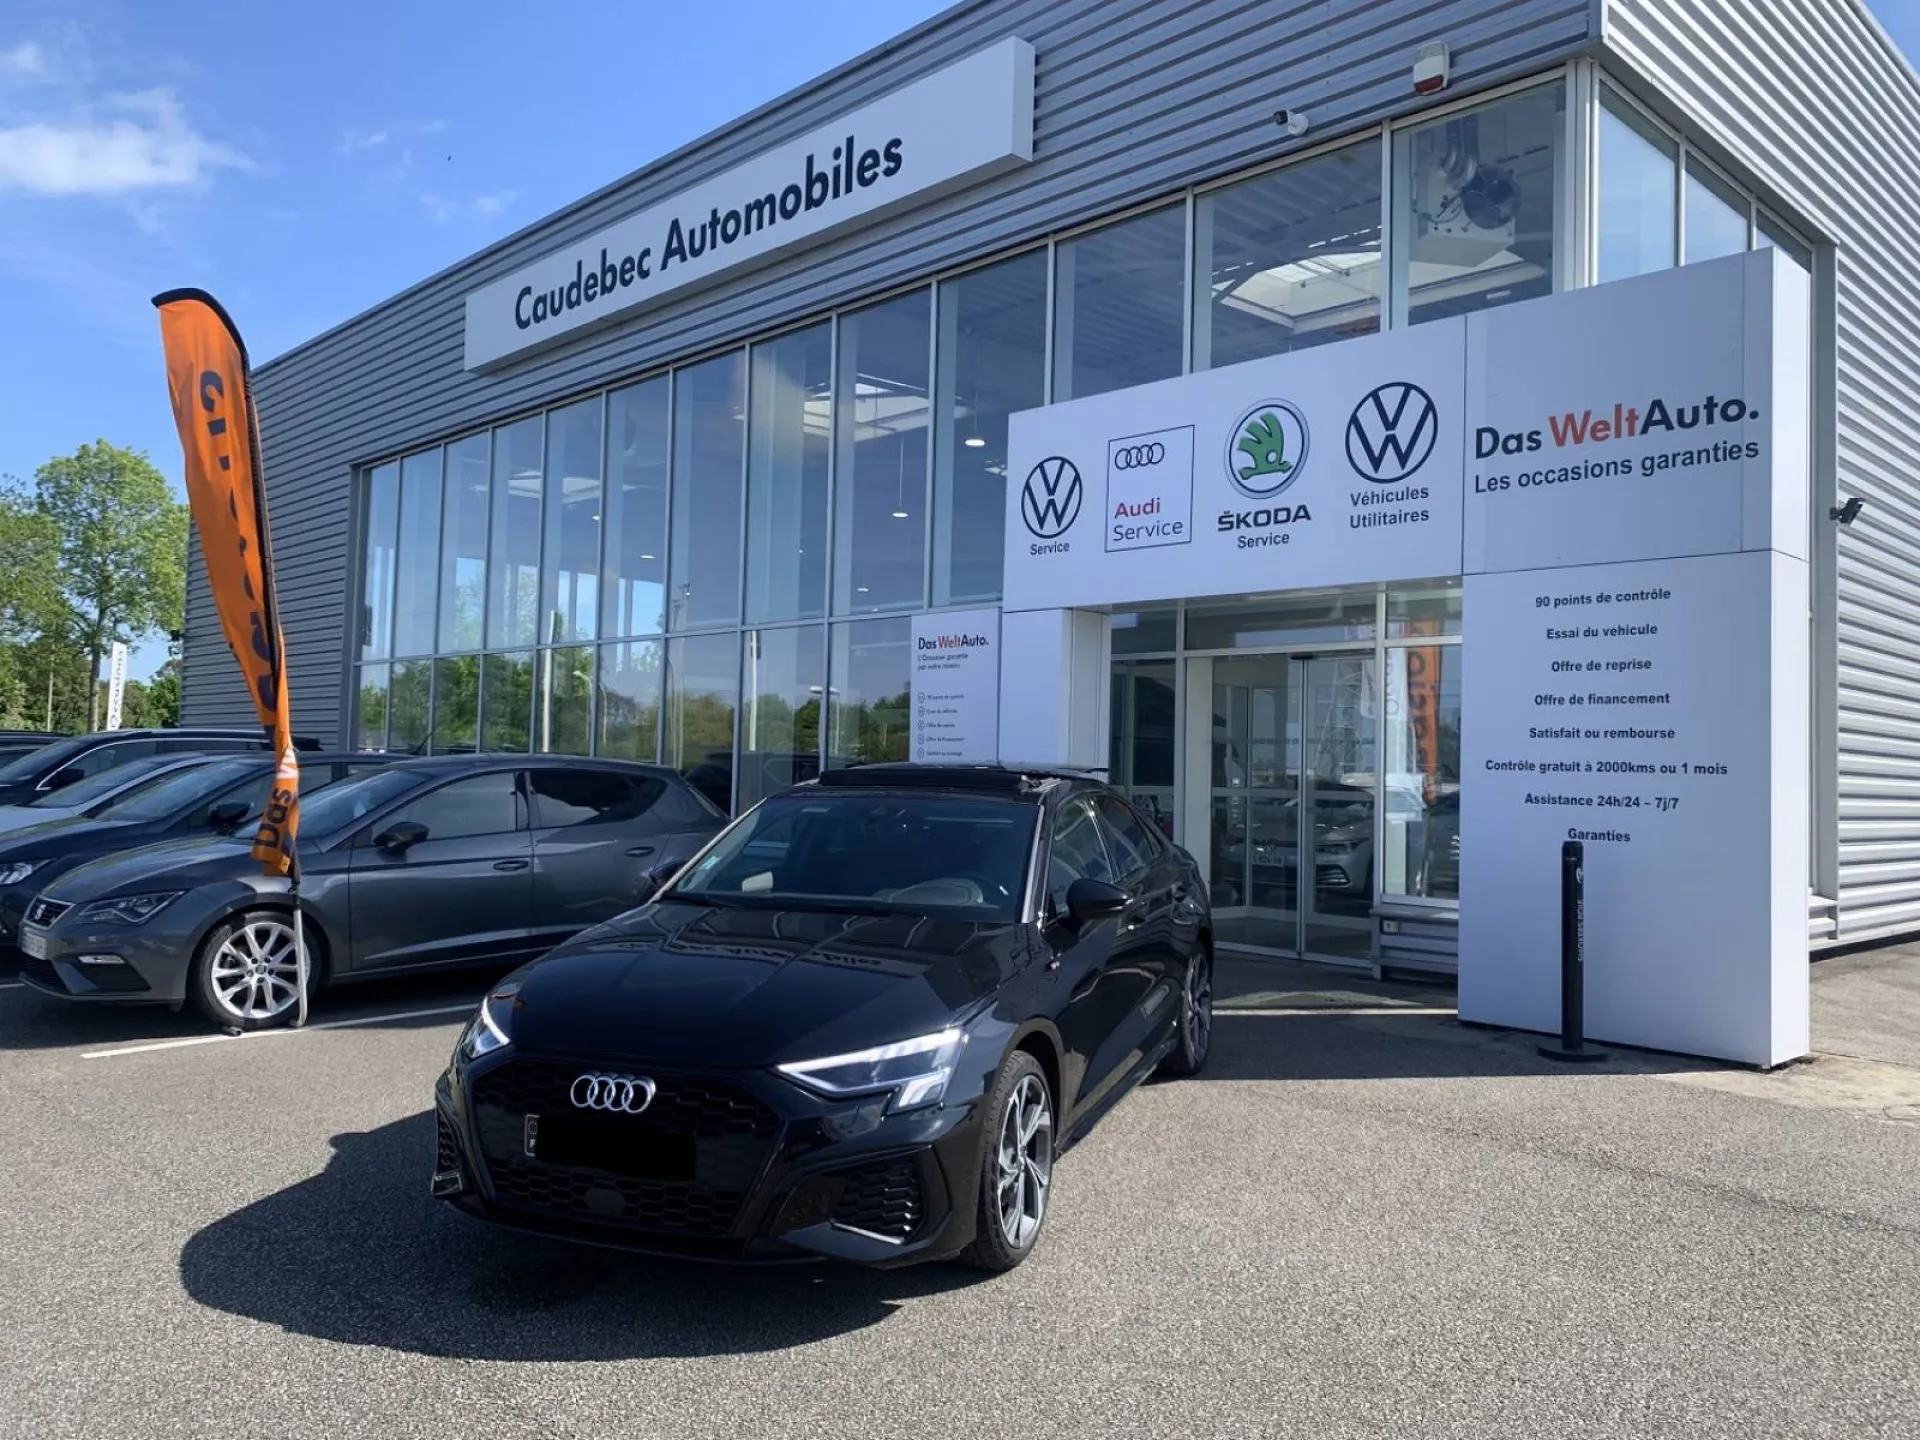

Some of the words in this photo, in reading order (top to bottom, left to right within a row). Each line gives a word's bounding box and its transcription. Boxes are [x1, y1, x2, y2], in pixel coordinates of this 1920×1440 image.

[515, 247, 651, 329] Caudebec
[660, 134, 903, 271] Automobiles
[1476, 427, 1541, 459] Das
[1476, 475, 1510, 493] Les
[1518, 459, 1632, 487] occasions
[1641, 441, 1758, 476] garanties
[1350, 485, 1429, 506] Véhicules
[1114, 497, 1161, 519] Audi
[1218, 505, 1311, 531] ŠKODA
[1350, 510, 1429, 528] Utilitaires
[1113, 519, 1183, 542] Service
[1236, 528, 1289, 549] Service
[1030, 539, 1070, 556] Service
[1536, 596, 1550, 607] 90
[1554, 595, 1592, 608] points
[1596, 593, 1611, 603] de
[1616, 588, 1671, 602] contrôle
[1547, 627, 1578, 639] Essai
[1584, 627, 1598, 637] du
[919, 637, 936, 649] Das
[1552, 661, 1582, 672] Offre
[1586, 660, 1601, 671] de
[1606, 659, 1651, 672] reprise
[1535, 695, 1565, 705] Offre
[1569, 694, 1584, 705] de
[1589, 693, 1670, 704] financement
[1530, 728, 1580, 738] Satisfait
[1585, 730, 1600, 738] ou
[1486, 760, 1535, 771] Contrôle
[1539, 762, 1580, 774] gratuit
[1585, 762, 1592, 772] à
[1597, 761, 1655, 773] 2000kms
[1660, 765, 1676, 773] ou
[1682, 763, 1687, 774] 1
[1694, 763, 1727, 774] mois
[1525, 793, 1593, 806] Assistance
[1597, 796, 1640, 807] 24h/24
[1655, 797, 1679, 811] 7j/7
[255, 788, 291, 848] Das
[1567, 827, 1631, 842] Garanties
